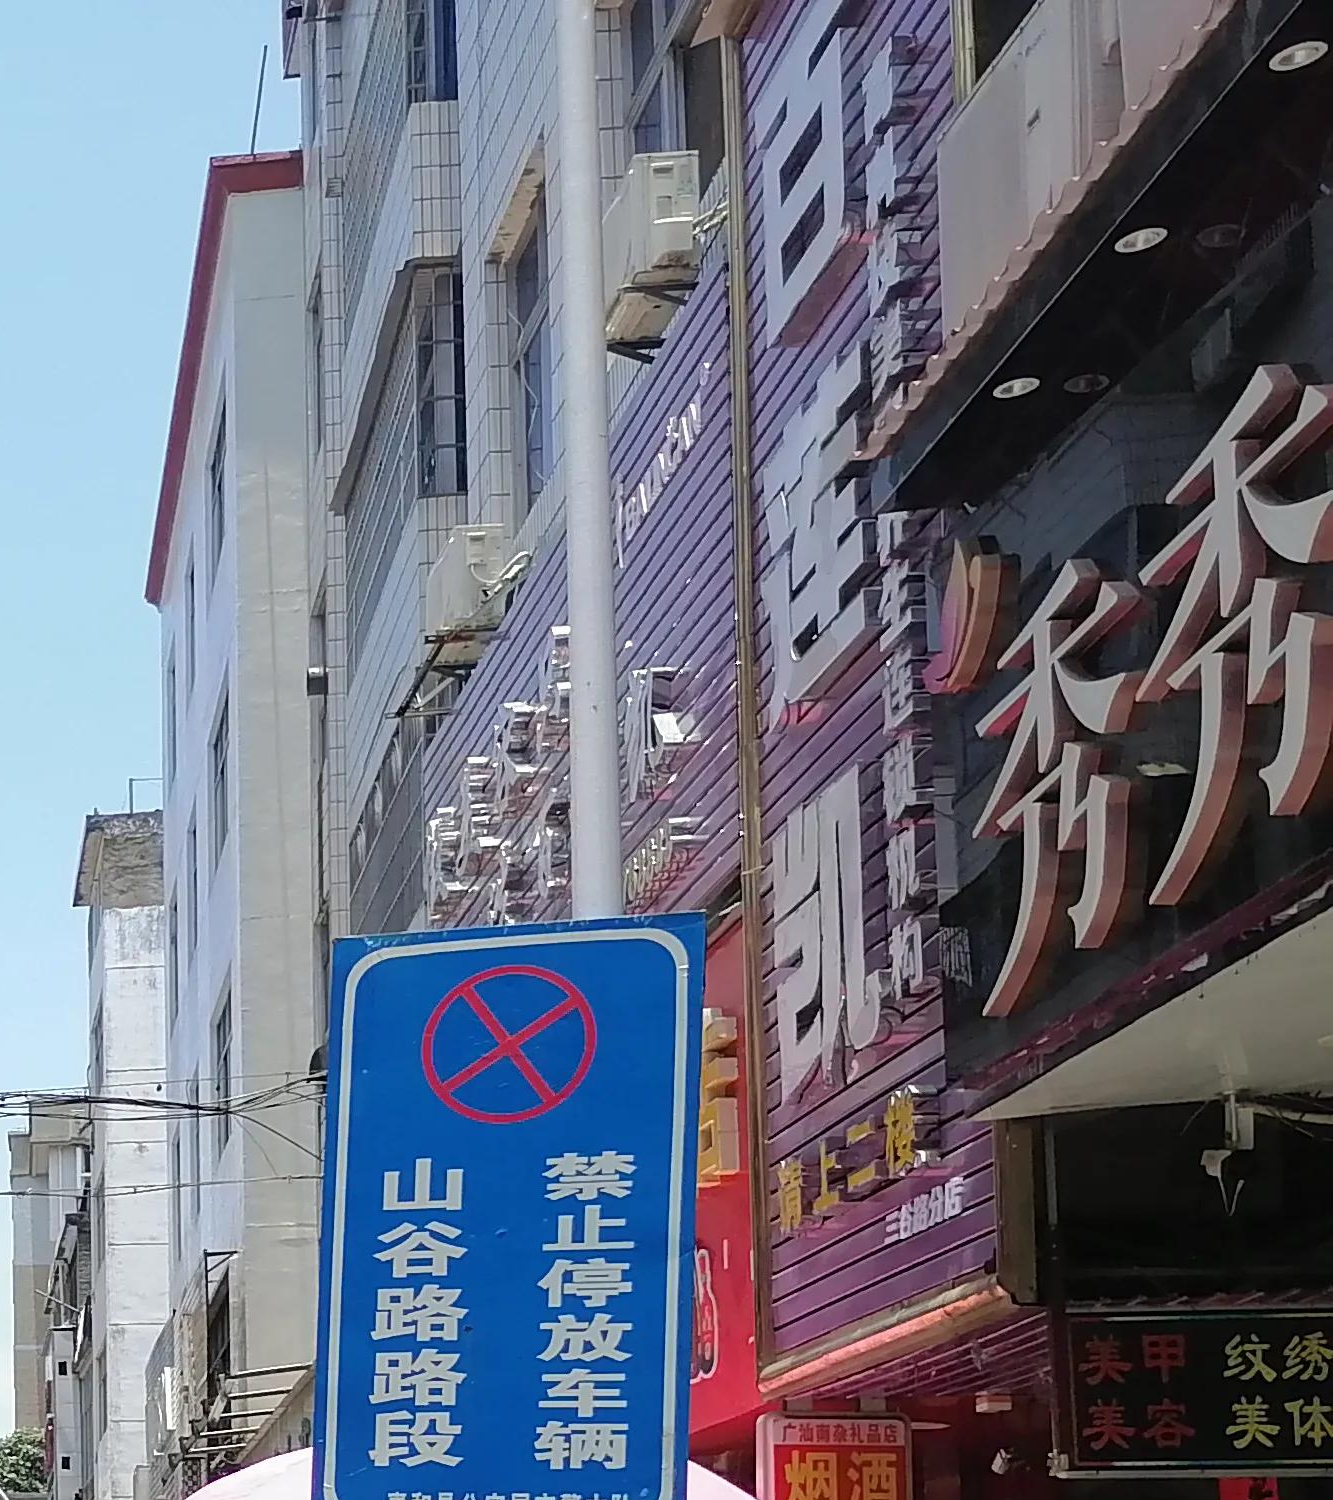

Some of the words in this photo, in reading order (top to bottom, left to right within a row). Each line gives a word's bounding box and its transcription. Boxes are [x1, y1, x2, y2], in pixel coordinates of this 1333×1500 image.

[973, 363, 1333, 1018] 秀秀
[367, 1157, 468, 1468] 山谷路路段
[533, 1150, 637, 1471] 禁止停放车辆
